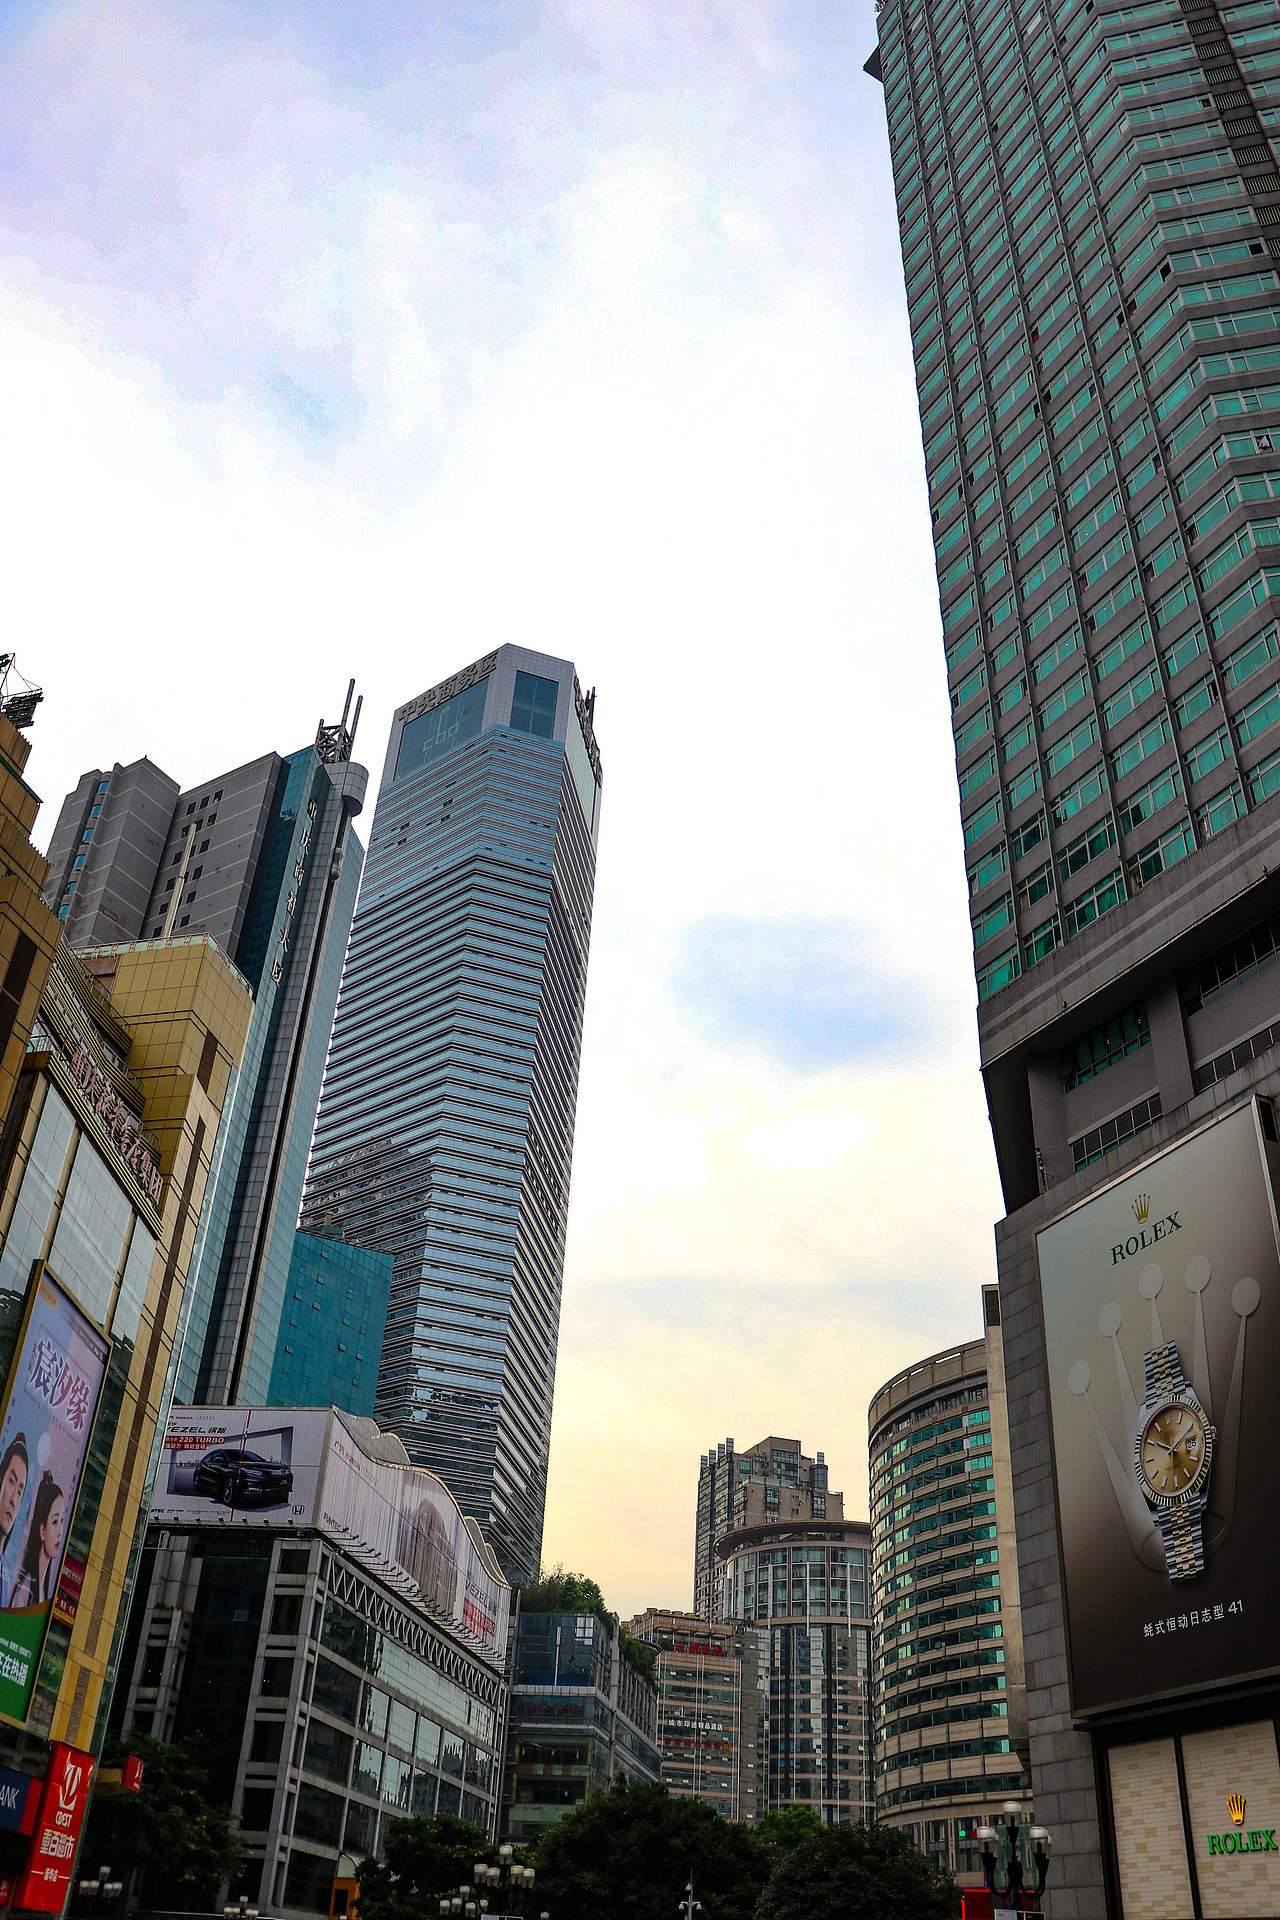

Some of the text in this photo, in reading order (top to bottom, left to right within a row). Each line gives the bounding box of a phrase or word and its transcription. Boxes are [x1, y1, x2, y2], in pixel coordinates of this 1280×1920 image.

[399, 651, 499, 723] 中央商务区
[1110, 1210, 1183, 1266] ROLEX
[29, 1338, 90, 1431] 宸汐缘
[195, 1436, 225, 1444] TURBO
[465, 1582, 488, 1609] VEZEL
[1143, 1599, 1244, 1638] 蚝式恒动日志型 41
[39, 1828, 75, 1859] 重百超市
[1206, 1828, 1279, 1855] ROLEX
